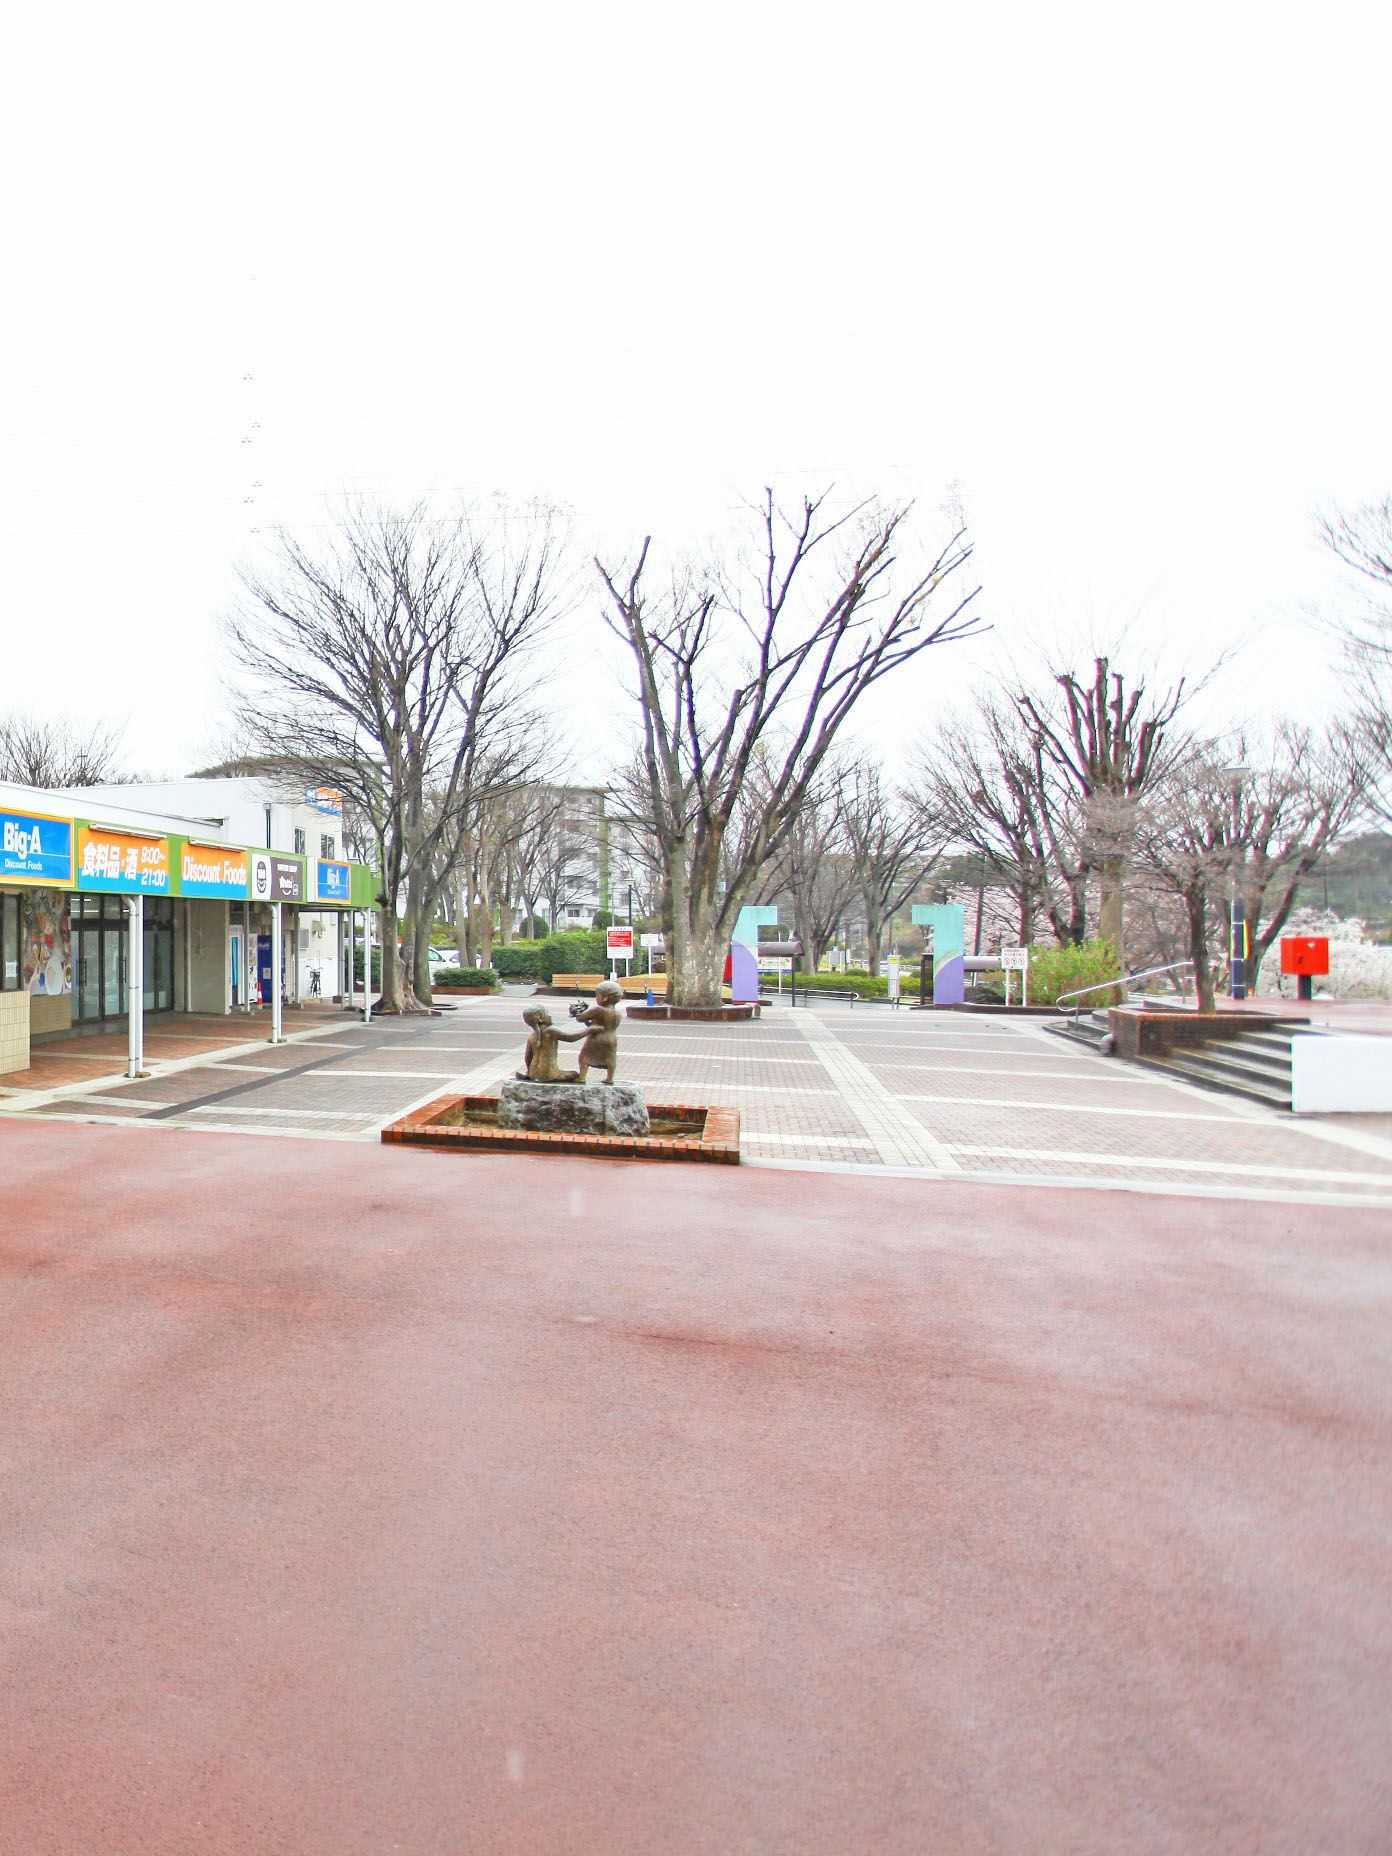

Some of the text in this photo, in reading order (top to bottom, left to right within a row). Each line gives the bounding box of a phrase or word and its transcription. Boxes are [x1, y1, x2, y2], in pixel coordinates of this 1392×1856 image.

[4, 858, 43, 871] Discount Foods
[183, 855, 247, 885] Discount Foods
[141, 867, 166, 887] 21:00
